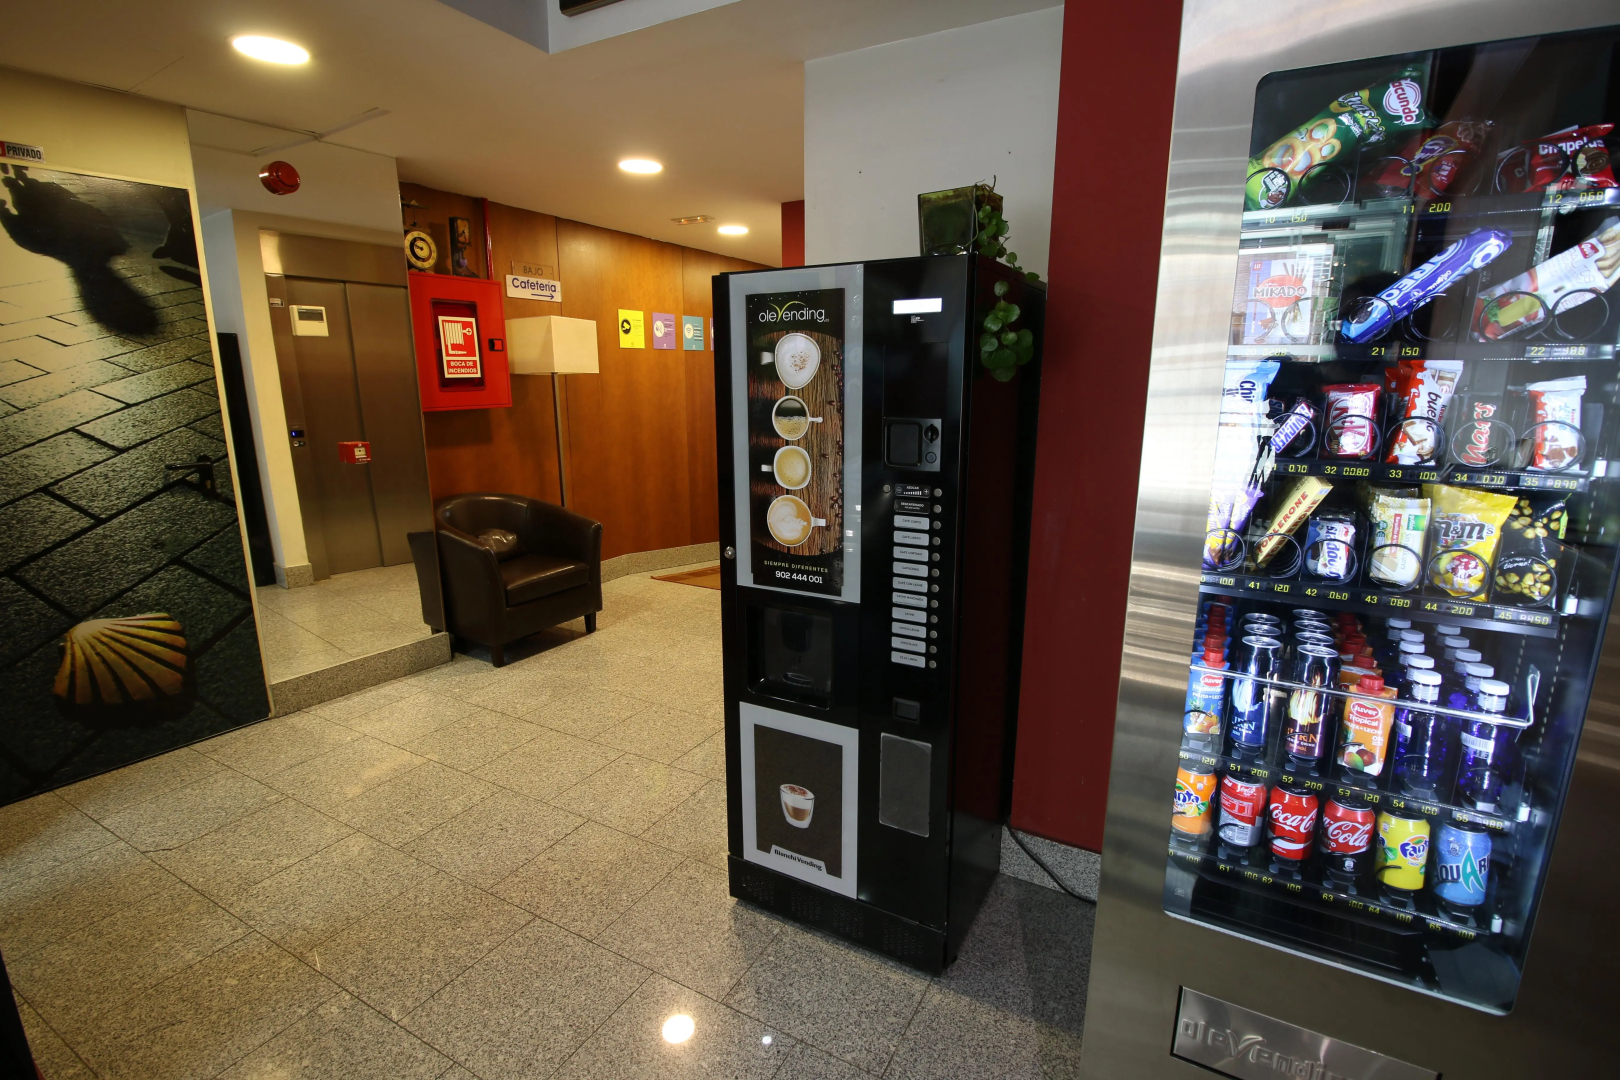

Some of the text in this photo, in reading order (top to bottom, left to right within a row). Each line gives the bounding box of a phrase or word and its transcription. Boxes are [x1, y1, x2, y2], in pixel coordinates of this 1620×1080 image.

[1390, 78, 1417, 123] acundo
[6, 145, 42, 160] PRIVADO
[523, 265, 543, 276] BAJO
[511, 277, 557, 293] Cafetería
[1253, 285, 1308, 298] MIKADO
[1371, 347, 1385, 355] 21
[1530, 346, 1545, 356] 22
[1324, 465, 1337, 475] 32
[1389, 469, 1402, 478] 33
[1454, 473, 1468, 482] 34
[1524, 477, 1538, 487] 35
[1256, 491, 1310, 553] TOBLERONE
[763, 560, 829, 573] SIEMPRE DIFERENTES
[775, 570, 823, 584] 902 444 001
[1248, 581, 1260, 590] 41
[1305, 588, 1318, 597] 42
[1365, 595, 1378, 604] 43
[1424, 602, 1438, 611] 44
[1498, 611, 1512, 621] 45
[1203, 676, 1223, 685] Juver
[1353, 704, 1378, 716] Juver
[1348, 713, 1379, 727] Tropical
[1229, 763, 1241, 772] 51
[1282, 775, 1294, 784] 52
[1338, 788, 1351, 797] 53
[1392, 799, 1405, 809] 54
[1455, 813, 1469, 823] 55
[1219, 864, 1230, 873] 61
[1262, 875, 1273, 884] 62
[1322, 893, 1334, 902] 63
[1368, 906, 1380, 914] 64
[1429, 922, 1442, 931] 65
